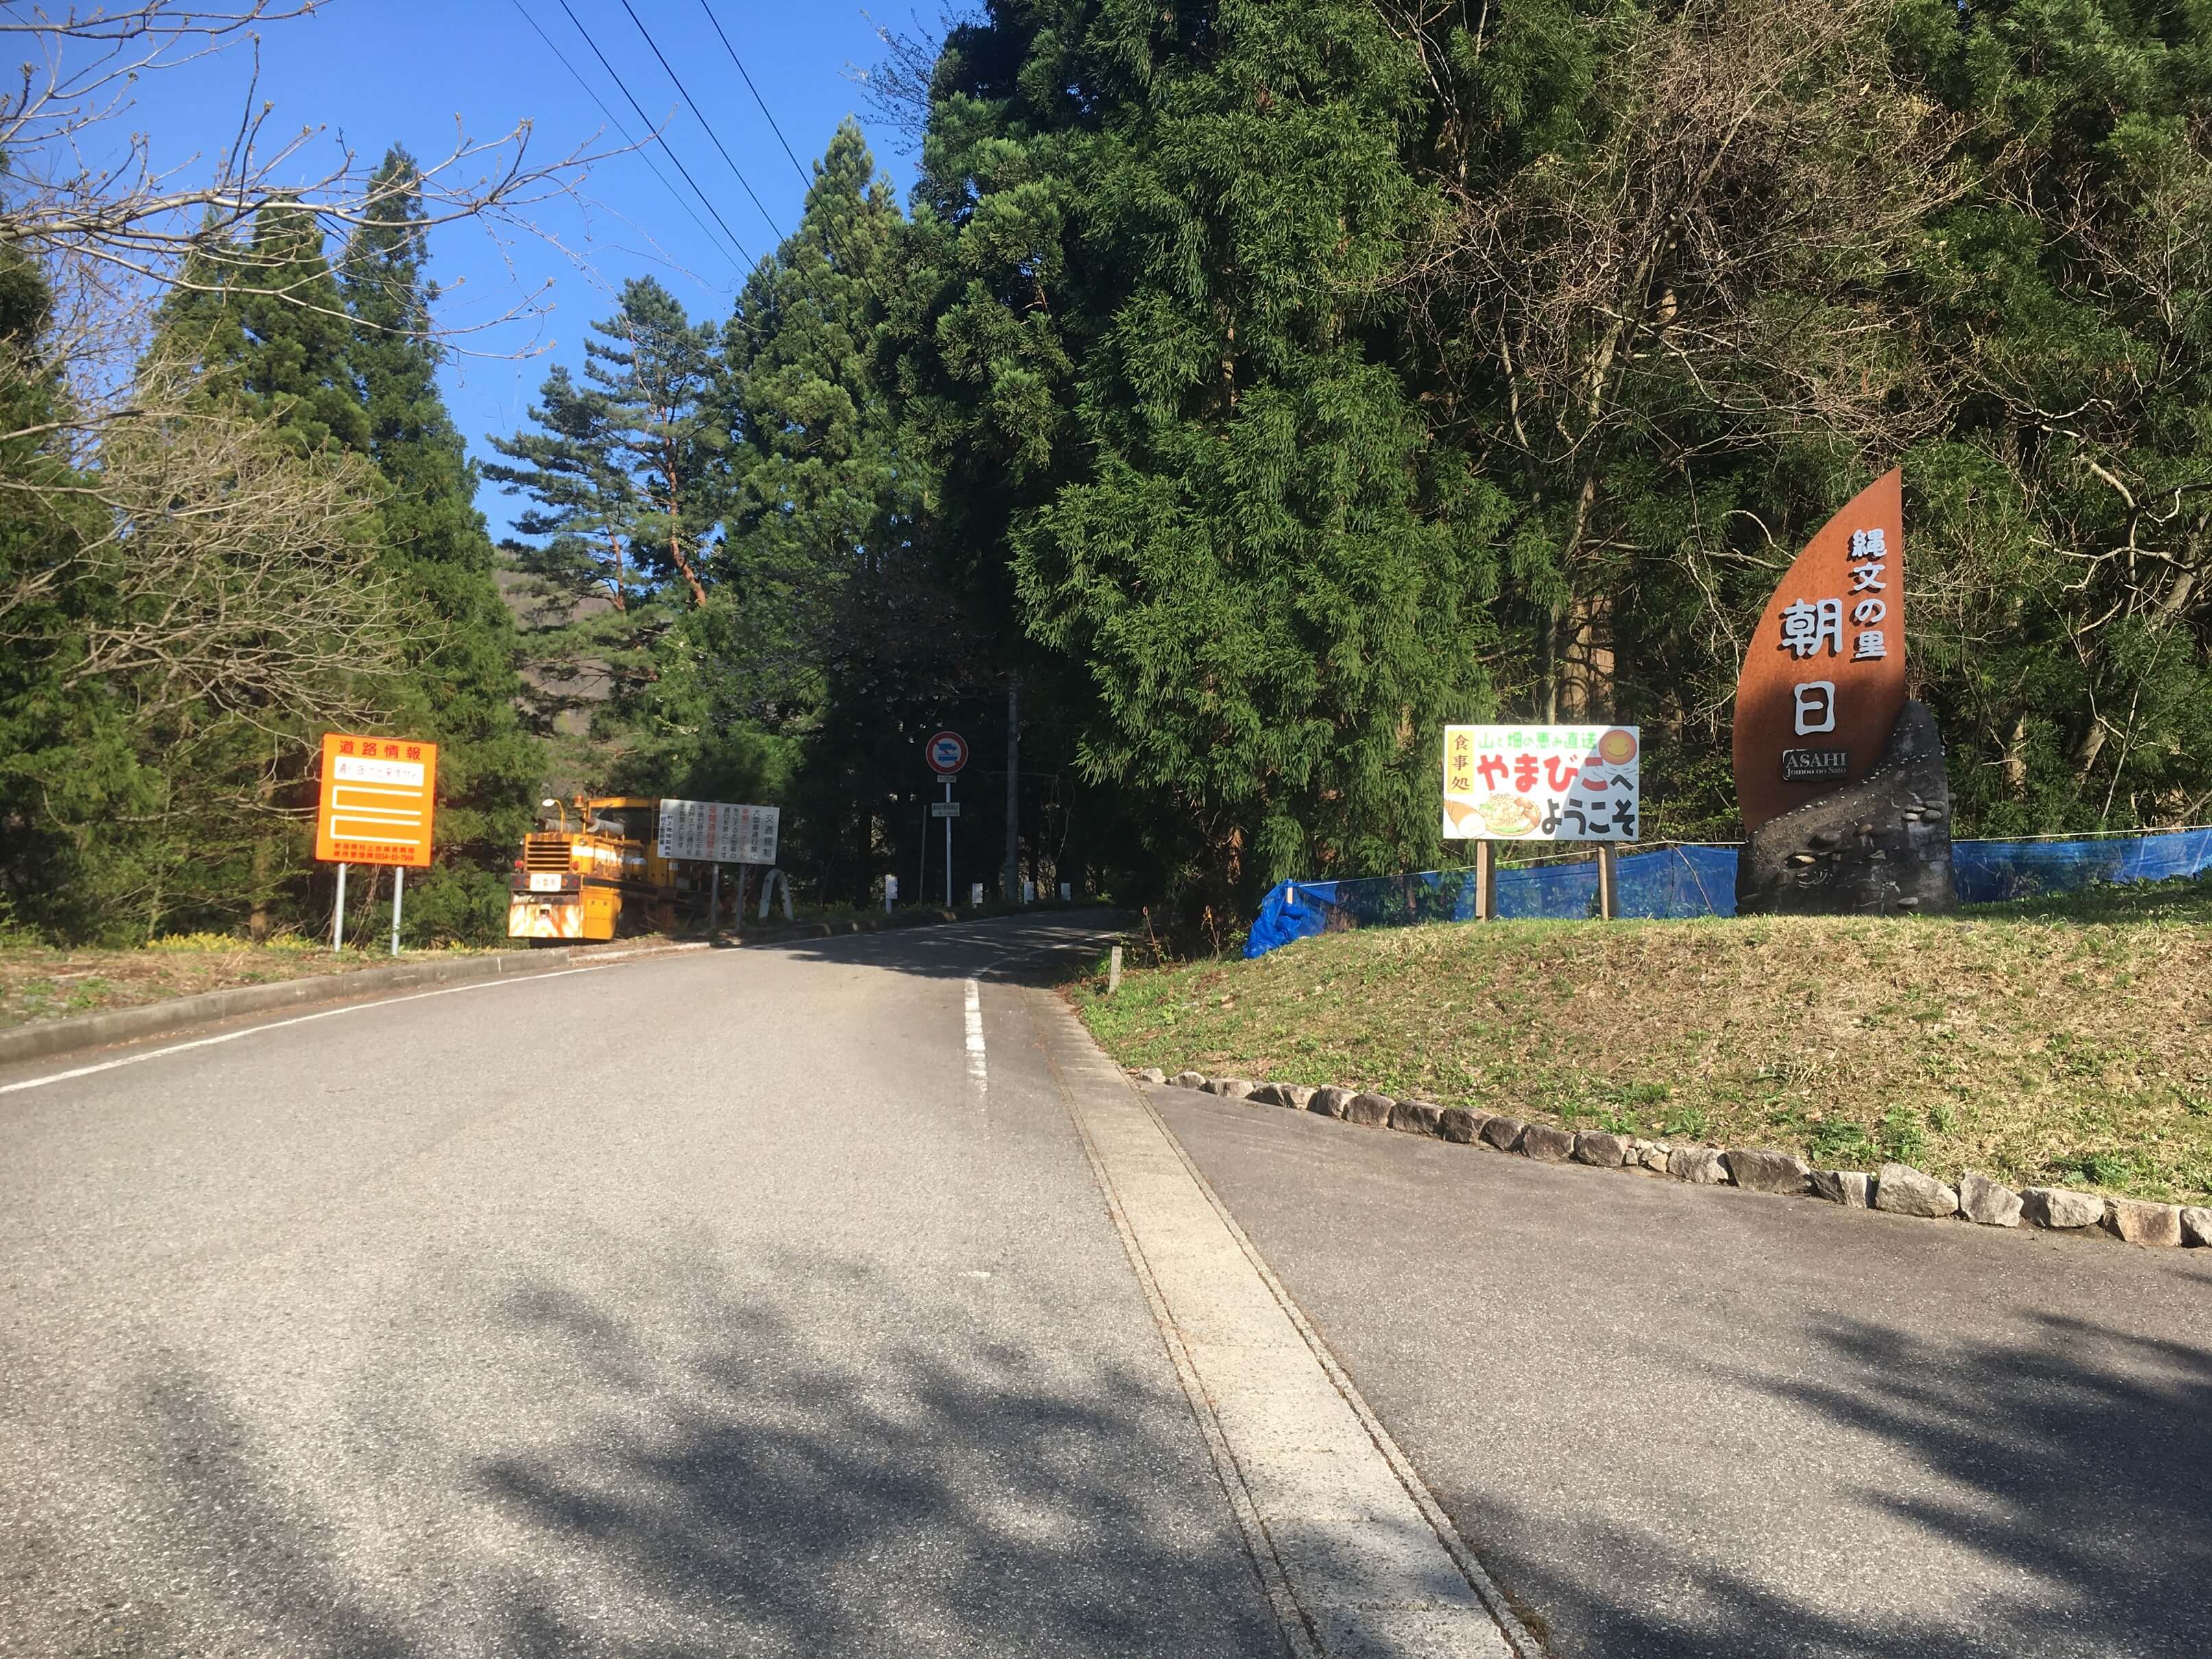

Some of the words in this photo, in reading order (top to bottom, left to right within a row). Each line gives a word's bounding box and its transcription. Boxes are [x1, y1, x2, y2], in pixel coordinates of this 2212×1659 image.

[1852, 528, 1888, 659] 縄文の里
[1783, 597, 1844, 737] 朝日
[339, 740, 422, 761] 道路情報
[1478, 731, 1597, 749] 山と畑の恵み直送
[1452, 734, 1470, 791] 食事処
[1476, 753, 1635, 793] やまびこへ
[1786, 753, 1847, 768] ASAHI
[1786, 768, 1814, 777] Jomon
[751, 810, 760, 860] 大型車通行禁止
[762, 814, 774, 858] 交通規制
[1541, 798, 1636, 836] ようこそ
